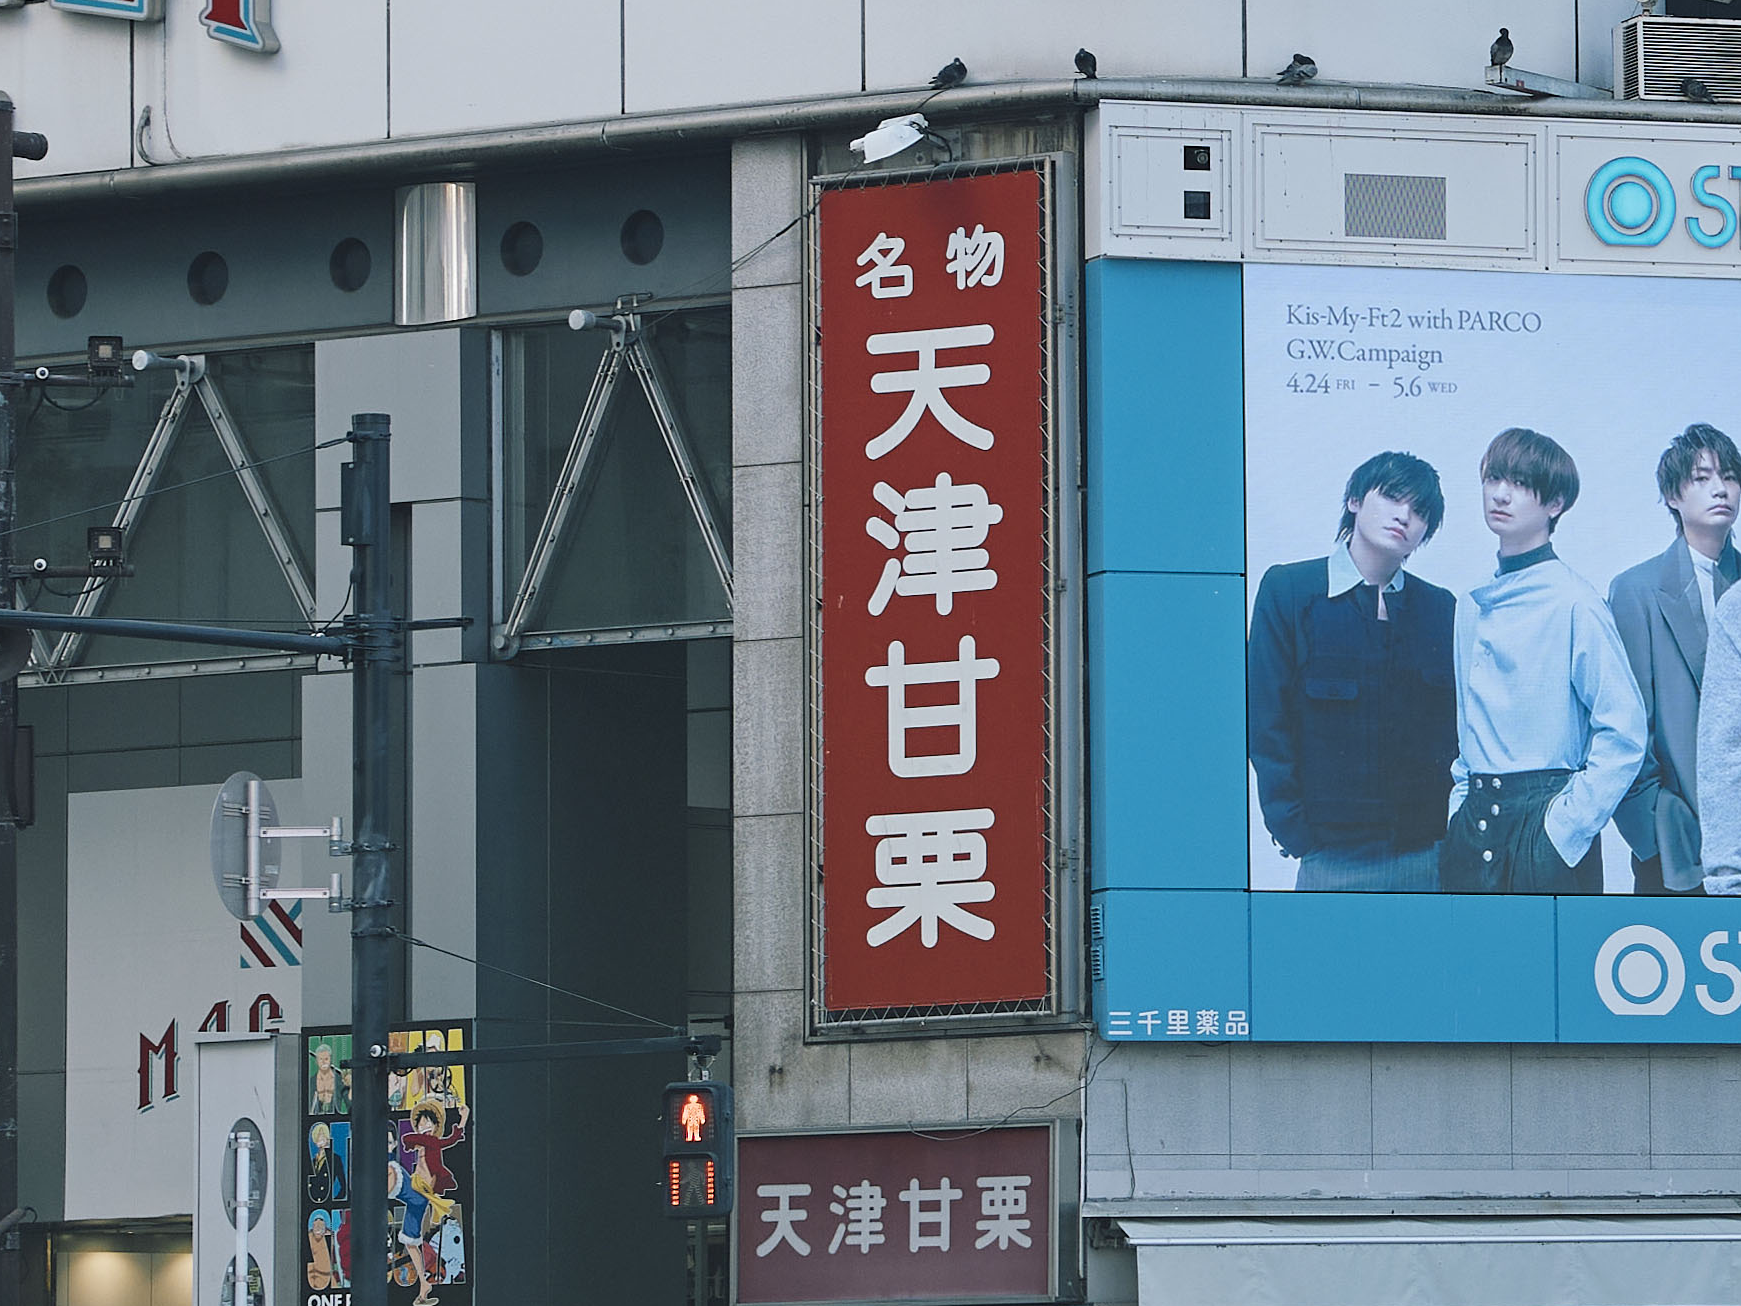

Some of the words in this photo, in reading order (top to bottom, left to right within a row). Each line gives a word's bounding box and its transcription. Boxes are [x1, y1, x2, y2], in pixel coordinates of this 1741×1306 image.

[855, 224, 1006, 302] 名物
[1286, 304, 1403, 334] Kis-My-Ft2
[1409, 309, 1454, 330] with
[1458, 309, 1542, 334] PARCO
[1286, 372, 1331, 395] 4.24
[1336, 379, 1355, 391] FRI
[1393, 376, 1422, 398] 5.6
[1428, 381, 1458, 394] WED
[864, 323, 1005, 950] 天津甘栗
[1108, 1010, 1250, 1037] 三千里薬品
[755, 1174, 1035, 1259] 天津甘栗
